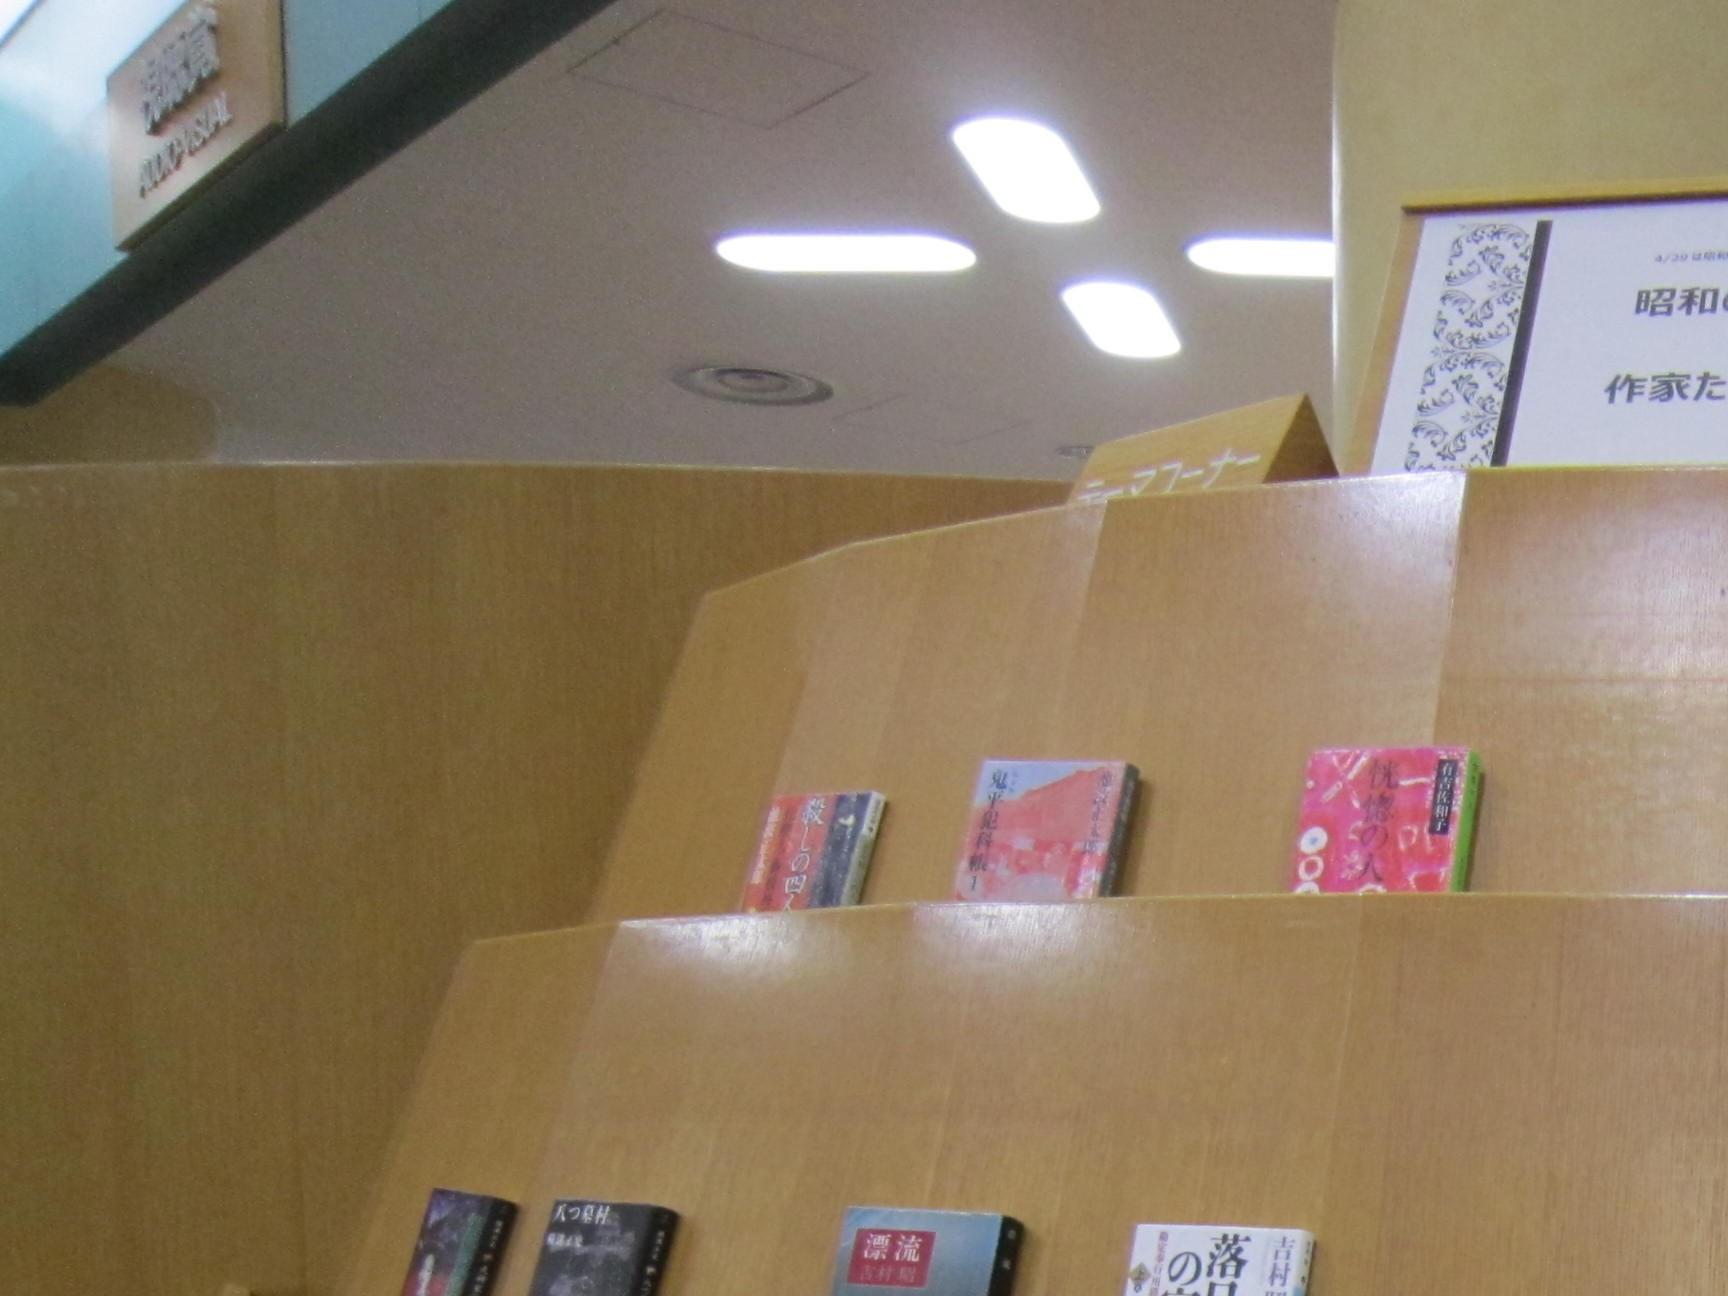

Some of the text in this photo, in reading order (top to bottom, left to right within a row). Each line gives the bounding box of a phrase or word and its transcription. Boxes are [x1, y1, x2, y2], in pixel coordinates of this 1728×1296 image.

[553, 1203, 610, 1225] 八つ墓村
[863, 1233, 922, 1262] 漂流
